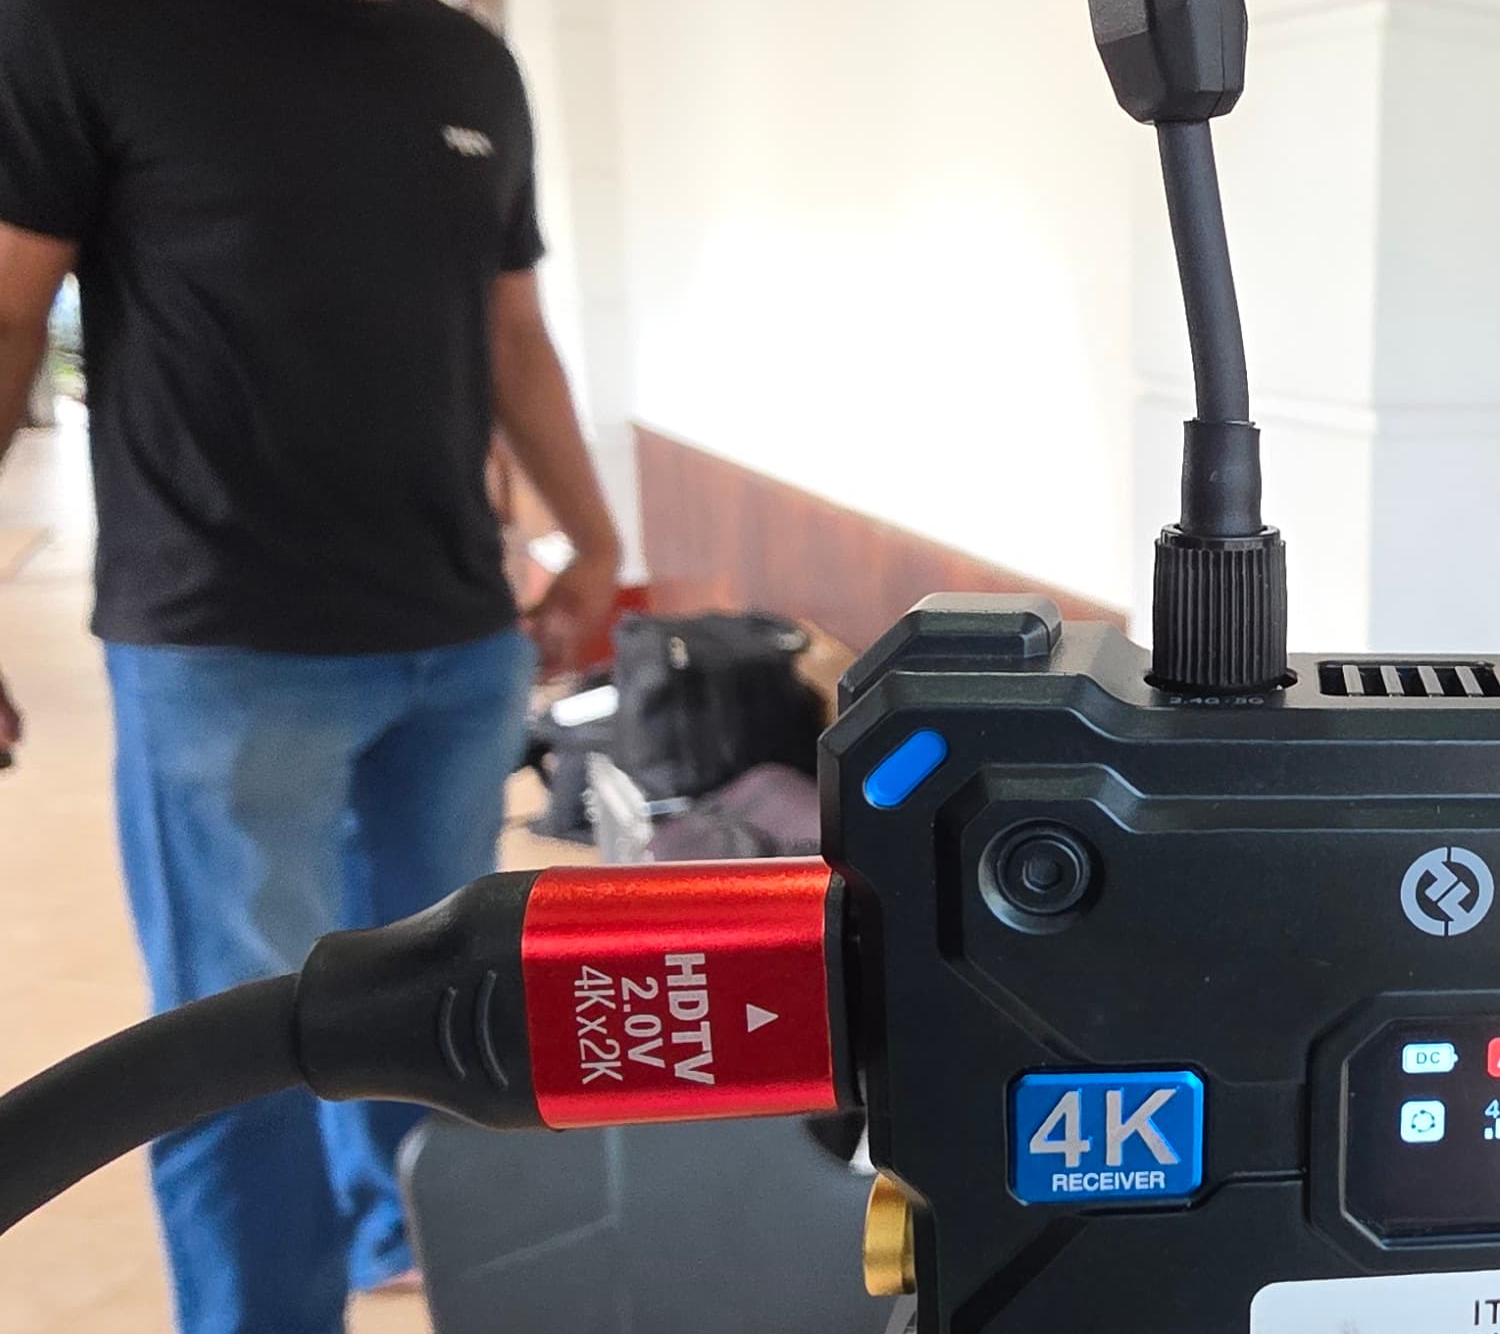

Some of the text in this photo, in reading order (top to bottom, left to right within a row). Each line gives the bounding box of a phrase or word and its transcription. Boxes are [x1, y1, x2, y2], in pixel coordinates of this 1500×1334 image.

[573, 965, 624, 1086] 4Kx2K
[620, 977, 666, 1069] 2.0V
[665, 952, 715, 1086] HDTV
[1416, 1051, 1441, 1065] DC
[1028, 1087, 1180, 1167] 4K
[1051, 1170, 1167, 1193] RECEIVER
